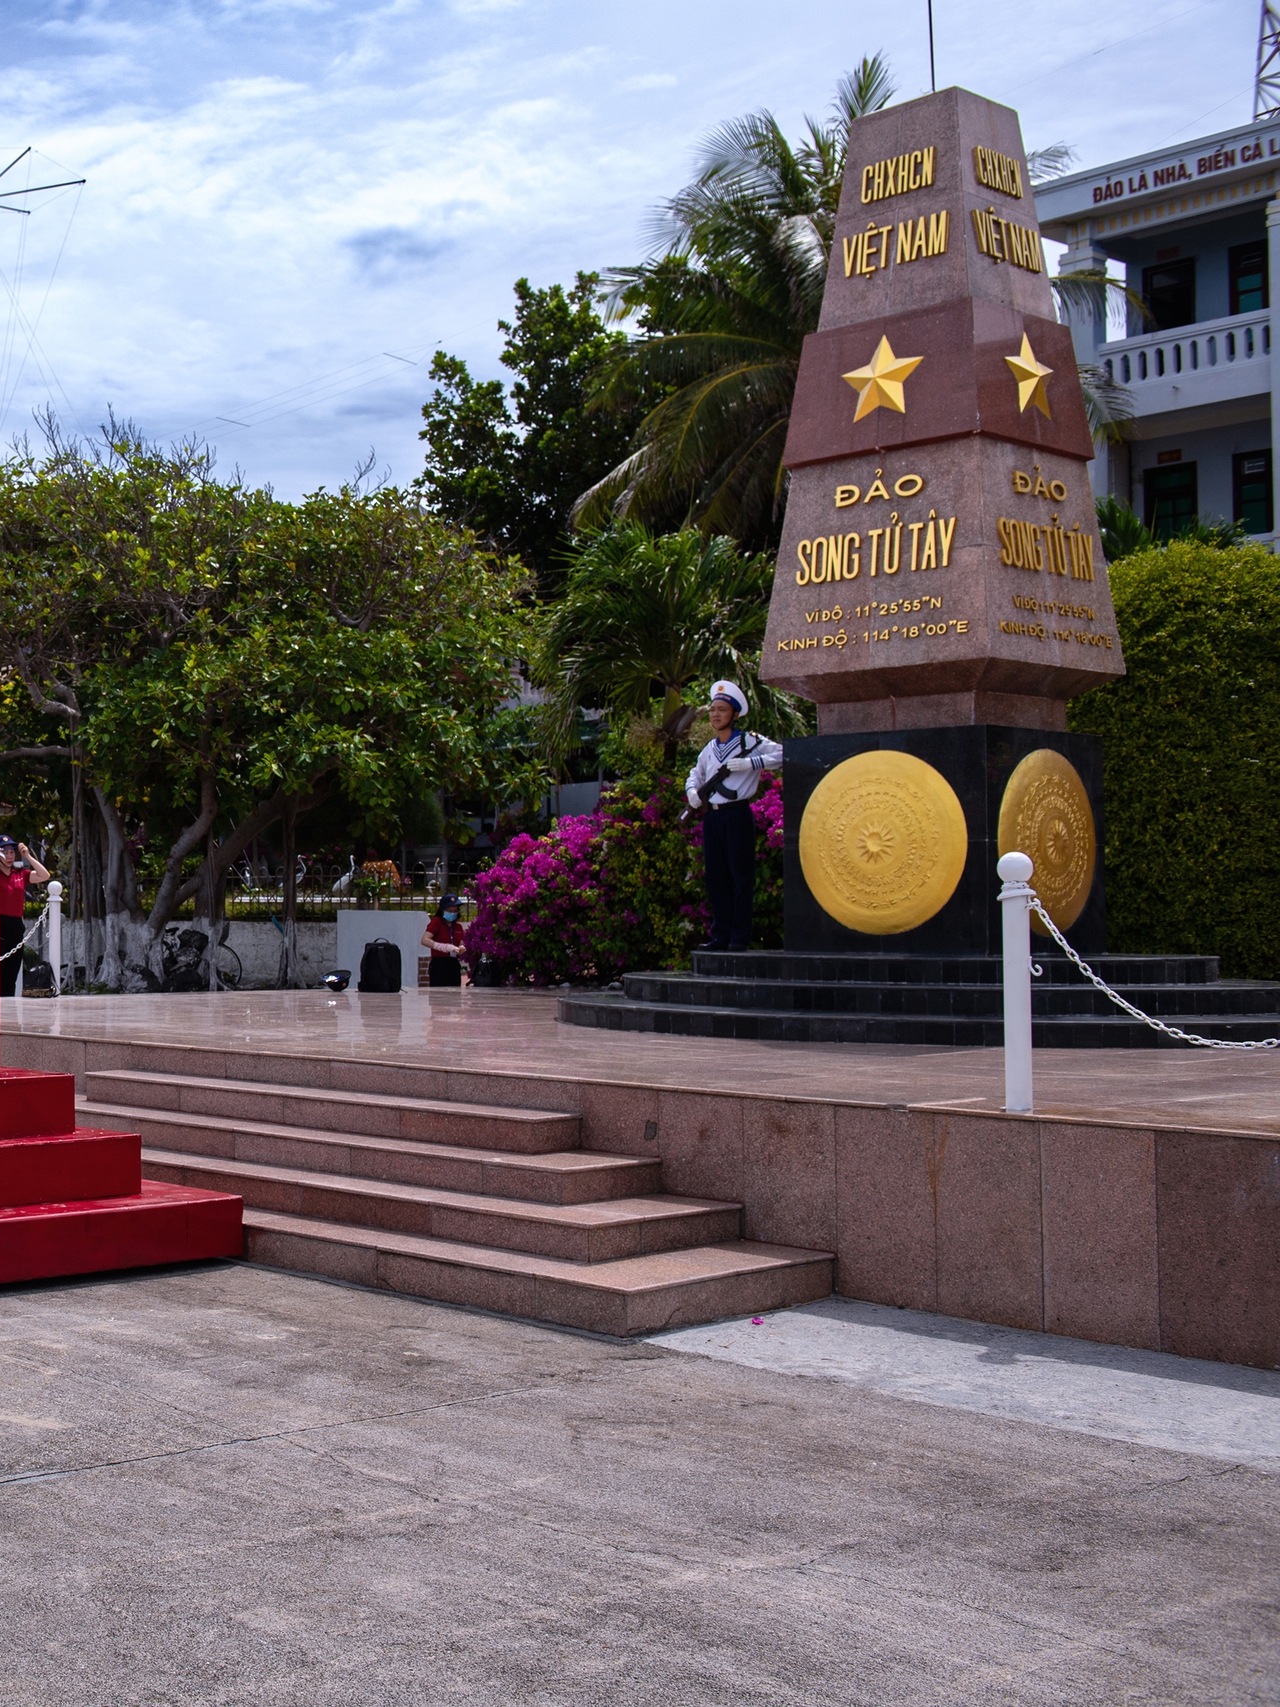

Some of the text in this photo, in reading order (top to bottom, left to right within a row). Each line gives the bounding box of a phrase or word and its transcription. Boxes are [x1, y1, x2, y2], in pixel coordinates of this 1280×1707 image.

[861, 145, 936, 204] CHXHCN
[973, 144, 1024, 199] CHXHCN
[1093, 176, 1124, 204] ĐẢO
[1128, 169, 1148, 194] LÀ
[1197, 143, 1237, 176] BIỂN
[1240, 136, 1264, 163] CẢ
[843, 209, 949, 279] VIỆT NAM
[972, 206, 1043, 273] VIỆT NAM
[834, 469, 924, 508] ĐẢO
[1013, 464, 1068, 502] ĐẢO
[795, 509, 957, 586] SONG TỬ TÂY
[997, 513, 1094, 581] SONG TỬ TÂY
[777, 637, 819, 651] KINH
[822, 629, 848, 649] ĐỘ
[822, 605, 843, 624] ĐỘ
[999, 620, 1027, 635] KINH
